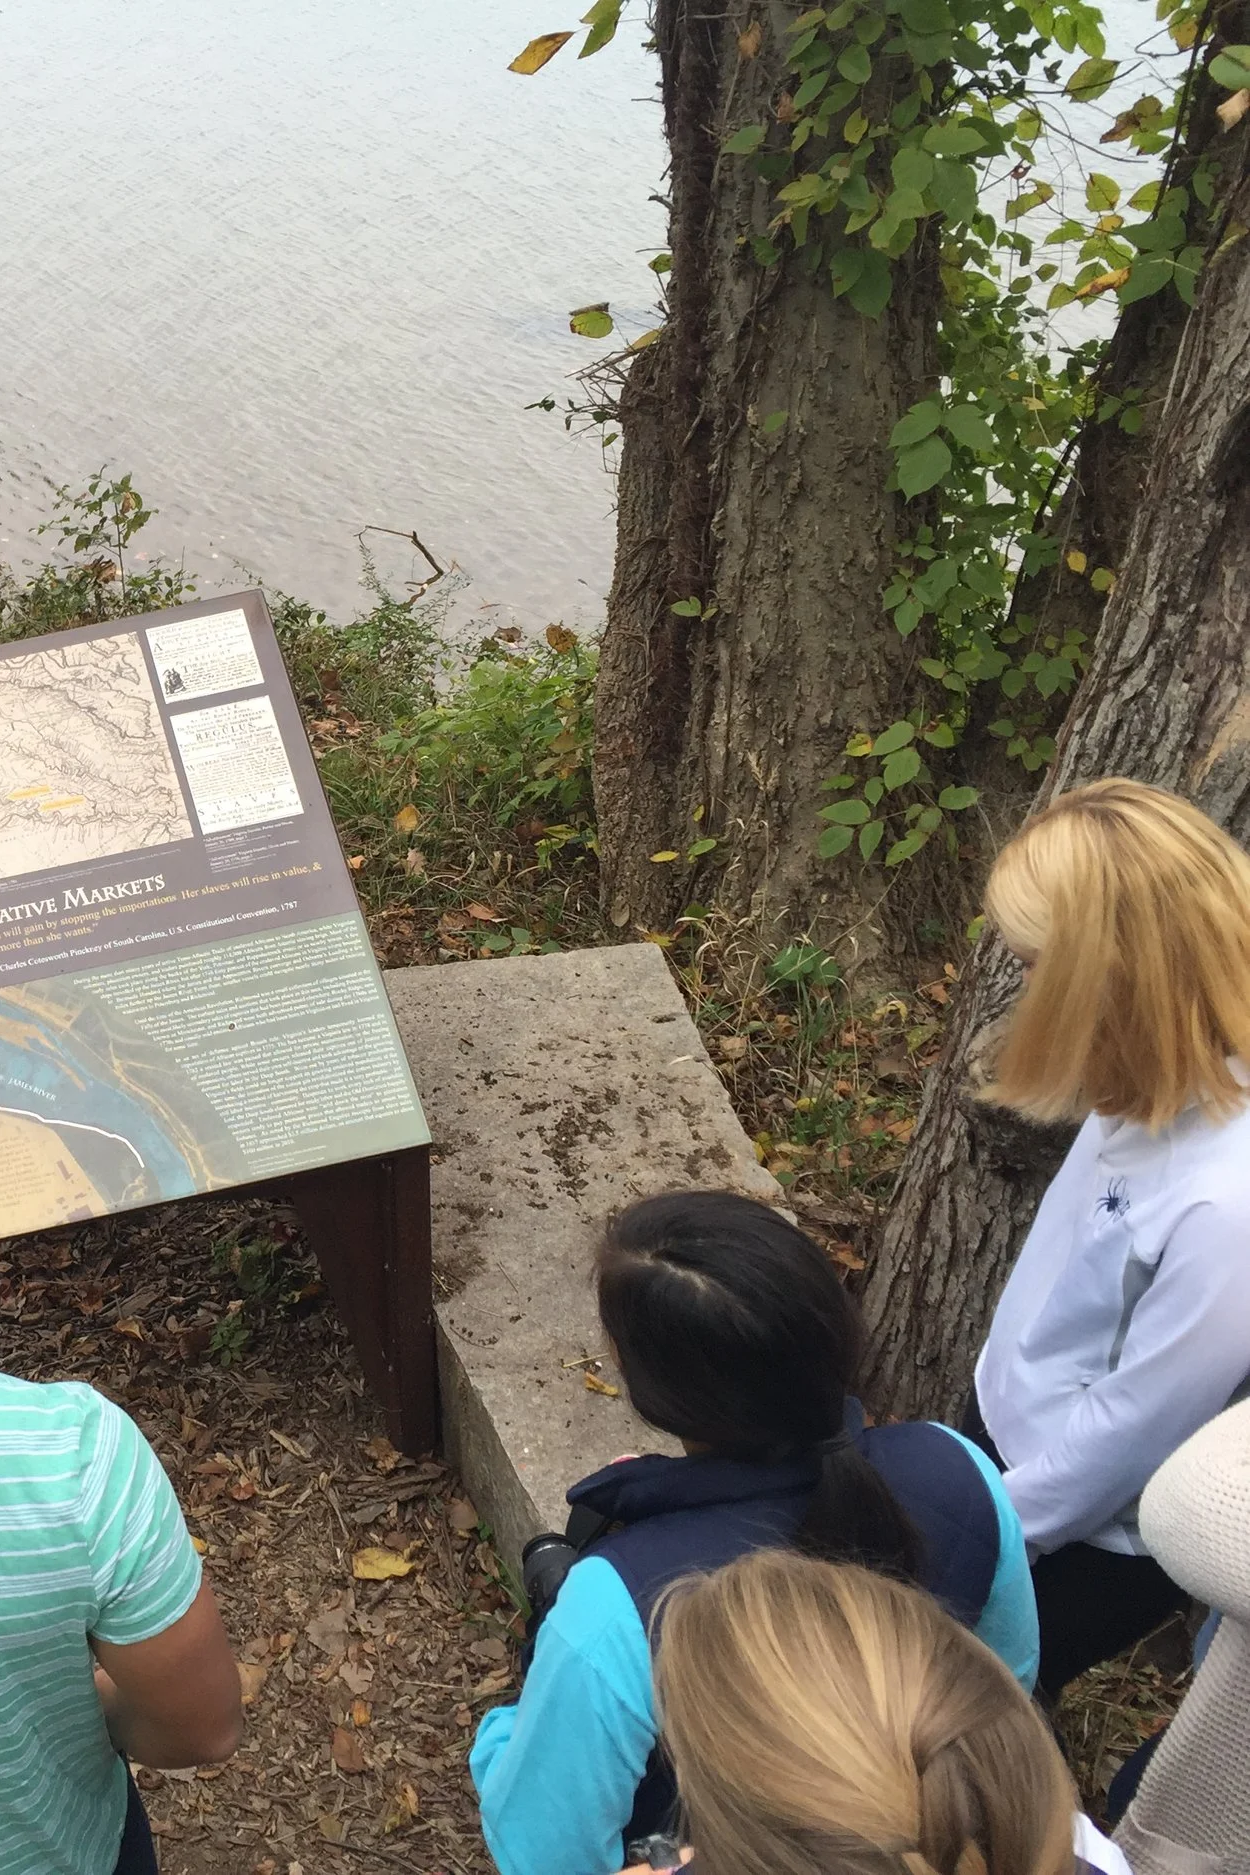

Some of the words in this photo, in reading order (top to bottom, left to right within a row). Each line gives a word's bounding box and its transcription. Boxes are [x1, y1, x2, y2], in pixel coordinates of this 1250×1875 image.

[3, 926, 22, 937] will
[24, 924, 44, 935] gain
[45, 920, 57, 929] by
[60, 912, 101, 925] stopping
[102, 907, 117, 916] the
[181, 890, 199, 899] Her
[201, 883, 230, 895] slaves
[231, 876, 250, 888] will
[252, 875, 269, 884] rise
[271, 872, 281, 880] in
[282, 866, 311, 876] value,
[313, 862, 322, 871] &
[62, 874, 165, 910] MARKETS
[0, 961, 27, 972] Charles
[28, 951, 69, 965] Cotesworth
[70, 945, 102, 957] Pinckney
[104, 941, 112, 949] of
[113, 937, 134, 947] South
[135, 932, 168, 942] Carolina,
[186, 914, 235, 931] Constitutional
[236, 907, 279, 920] Convention,
[281, 901, 297, 911] 1787
[23, 937, 44, 947] than
[46, 932, 62, 942] she
[8, 1077, 33, 1092] JAMES
[33, 1086, 57, 1101] RIVER
